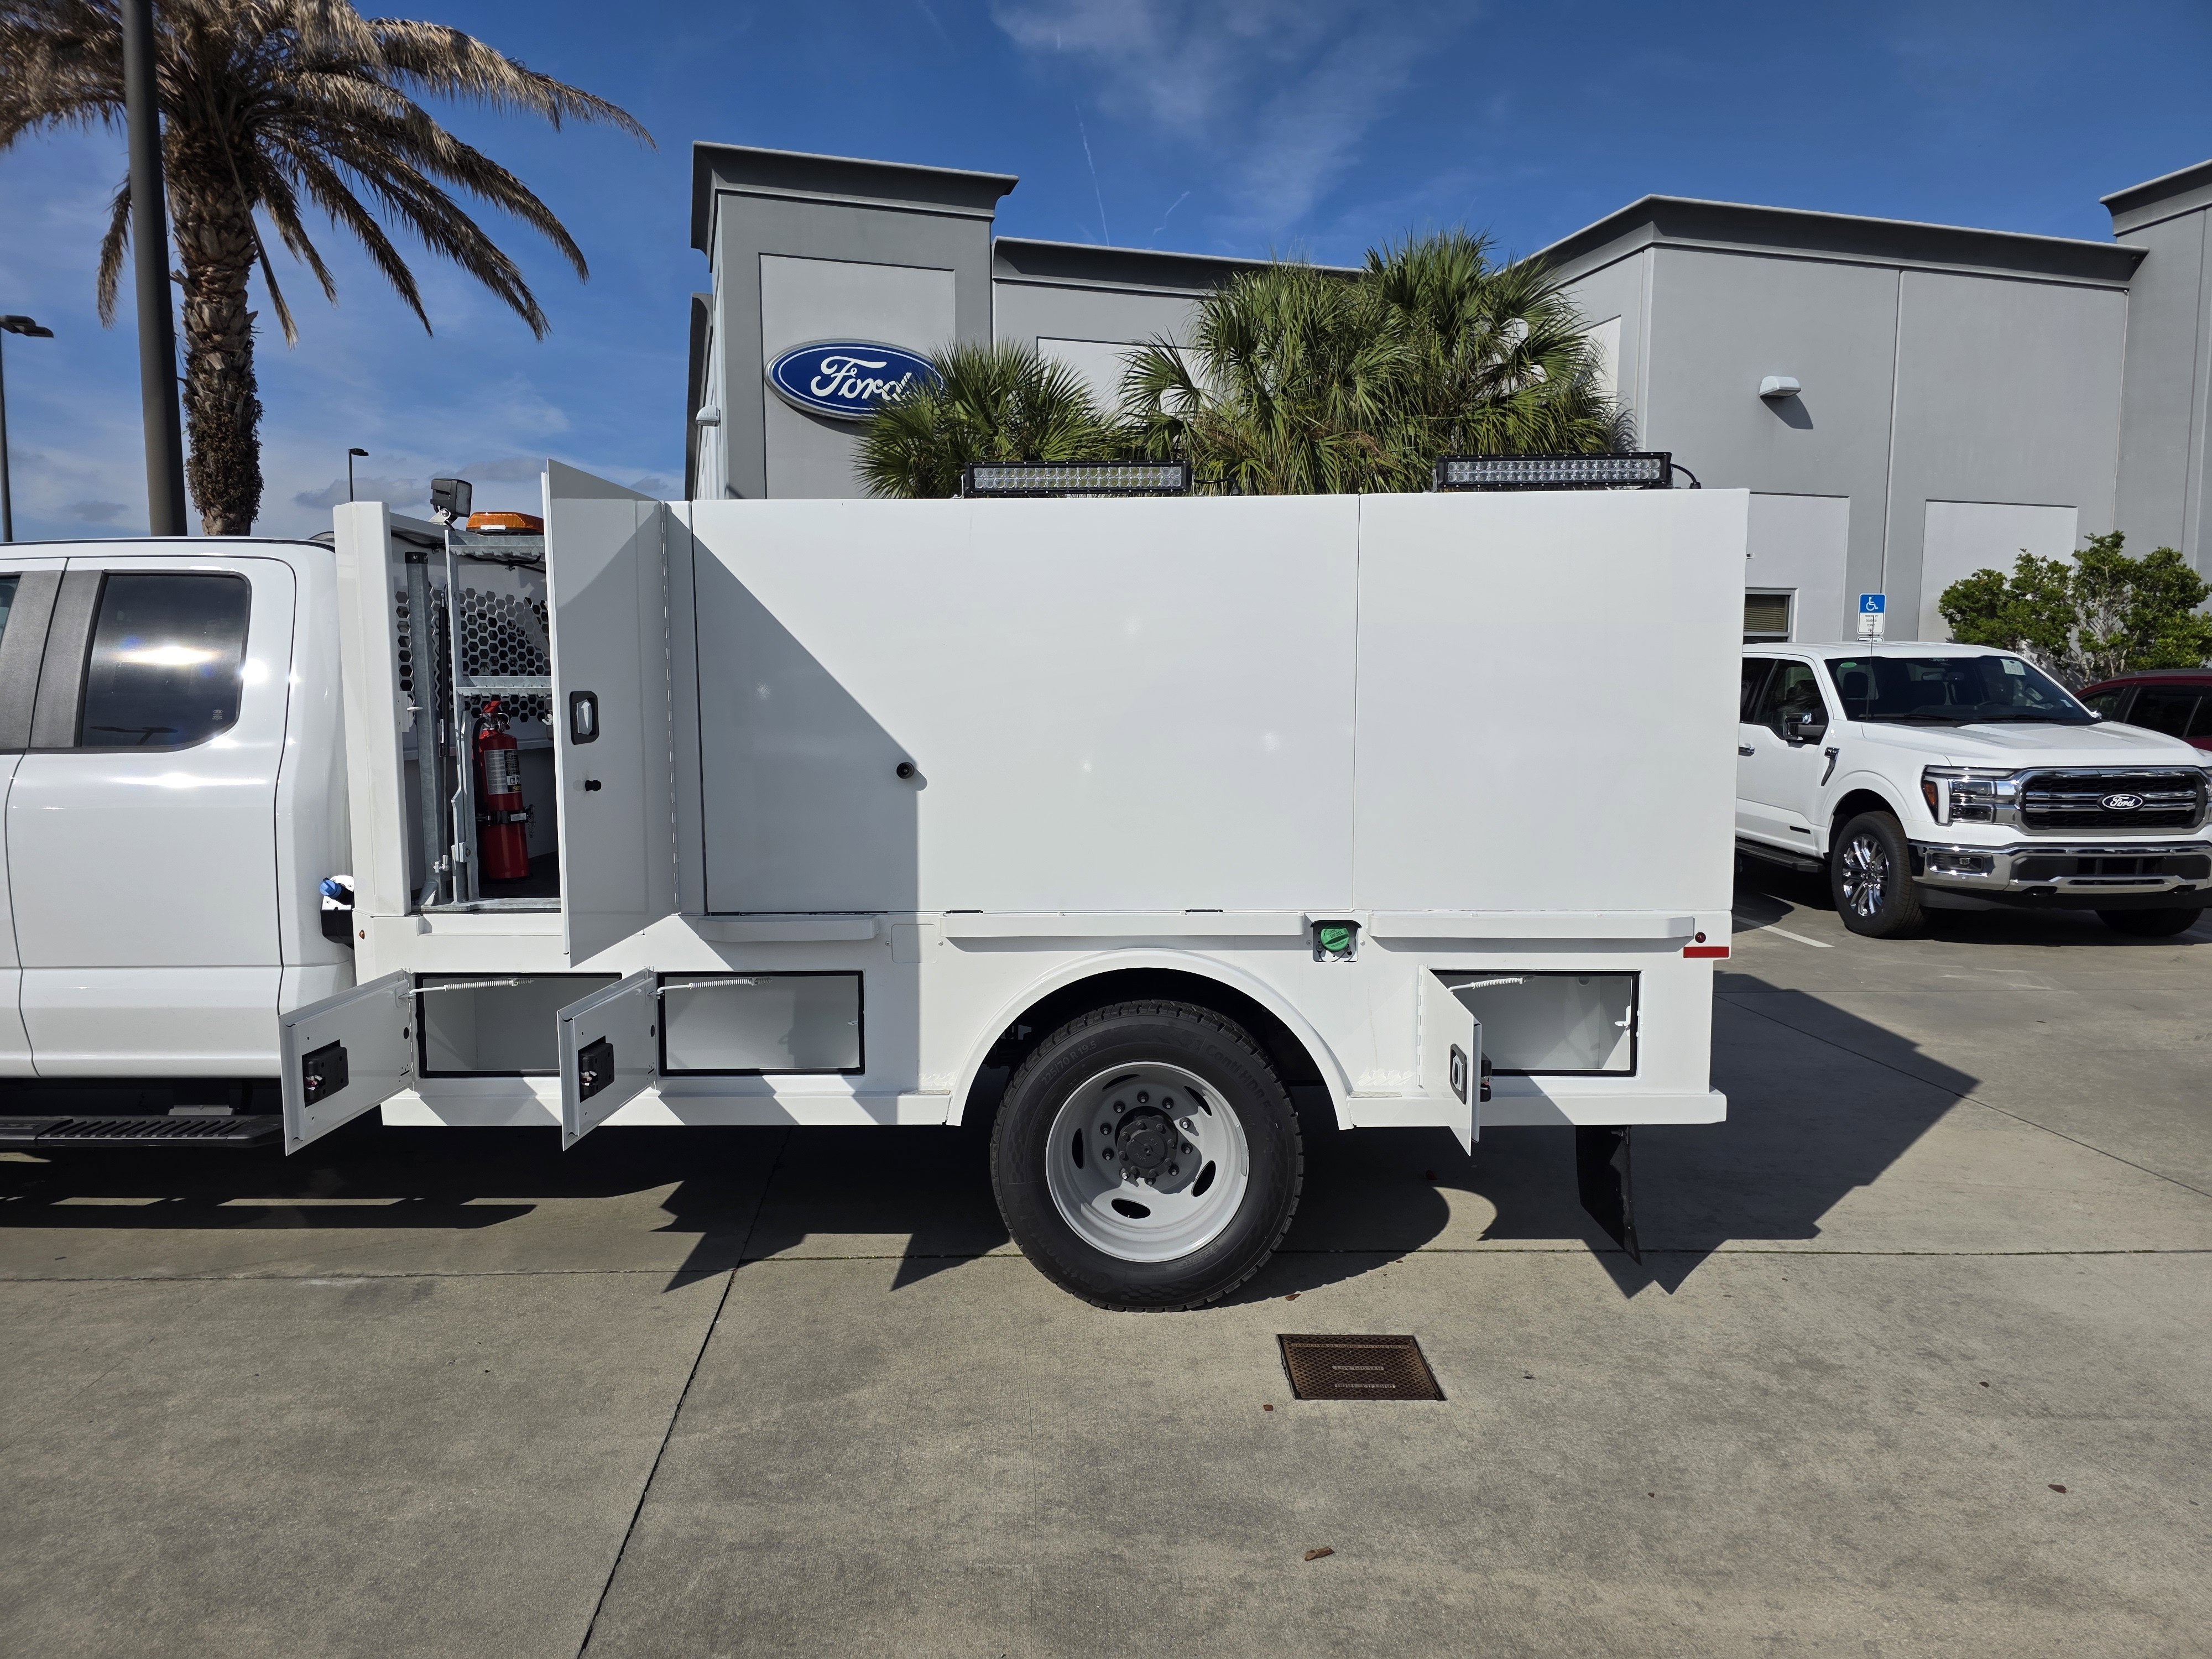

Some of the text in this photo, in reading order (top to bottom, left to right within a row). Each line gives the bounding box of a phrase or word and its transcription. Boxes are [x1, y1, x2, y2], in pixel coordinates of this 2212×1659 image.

[810, 356, 912, 402] Ford
[2006, 664, 2022, 674] 590
[2110, 796, 2135, 807] Ford
[1041, 1057, 1070, 1084] 225/70
[1070, 1051, 1079, 1060] R
[1078, 1040, 1097, 1055] 19.5
